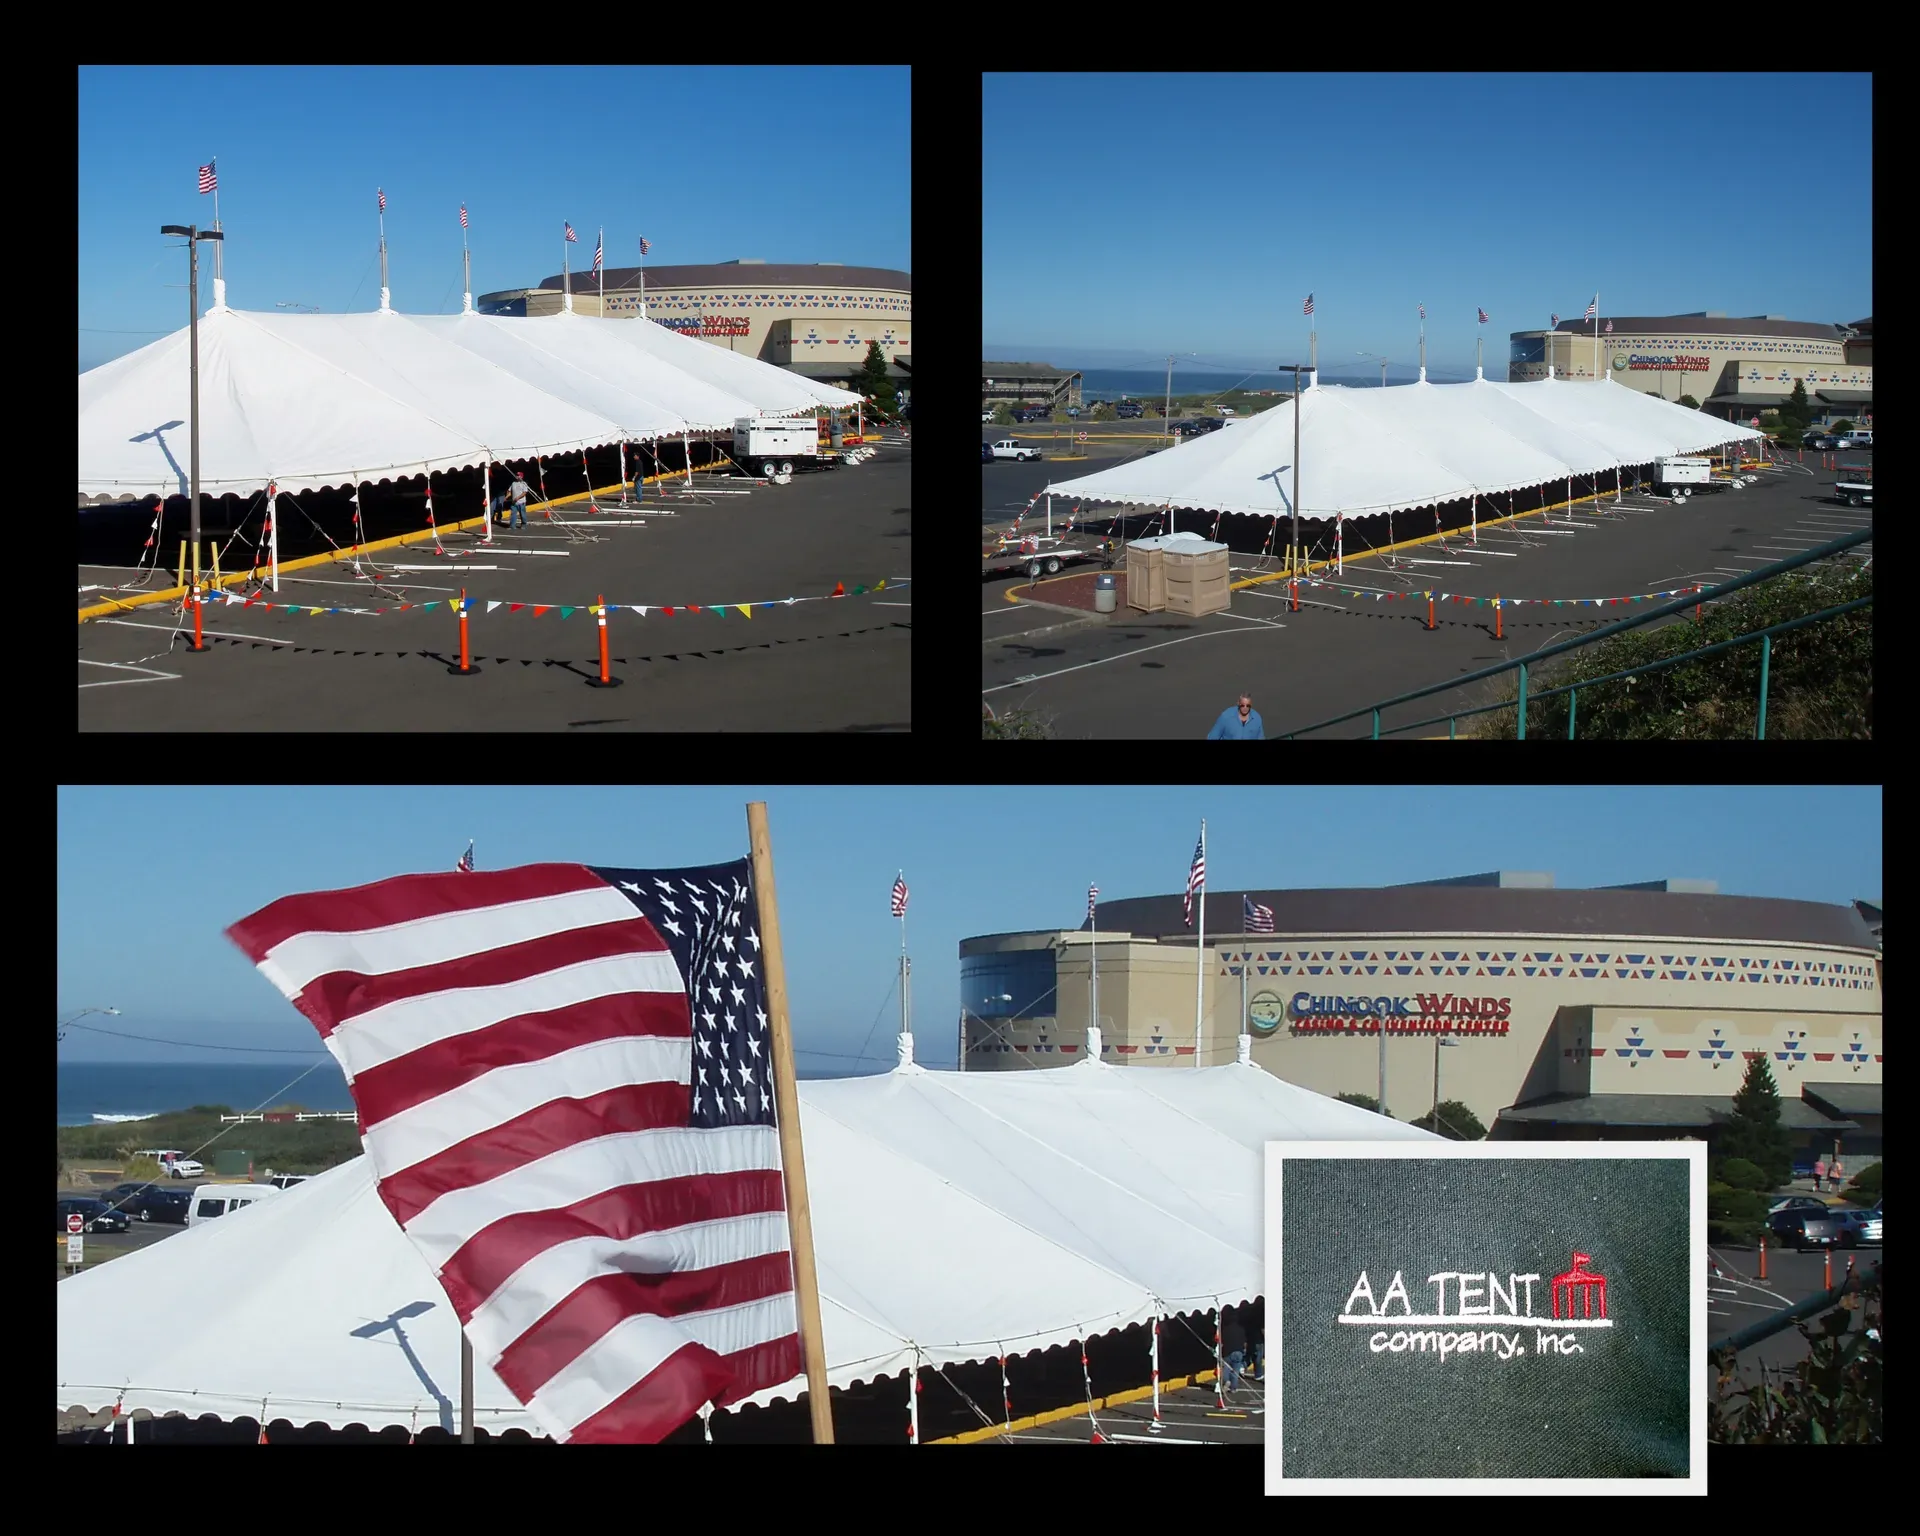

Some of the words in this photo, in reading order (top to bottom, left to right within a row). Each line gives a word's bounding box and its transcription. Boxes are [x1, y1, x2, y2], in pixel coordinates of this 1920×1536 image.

[650, 317, 701, 328] HINOOK
[1629, 354, 1673, 364] CHINOOK
[1675, 355, 1711, 365] WINDS
[1291, 992, 1411, 1015] CHINOOK
[1415, 993, 1511, 1018] WINDS
[1295, 1017, 1345, 1033] CASINO
[1456, 1018, 1510, 1034] CENTER
[1345, 1270, 1412, 1316] AA
[1427, 1271, 1541, 1317] TENT
